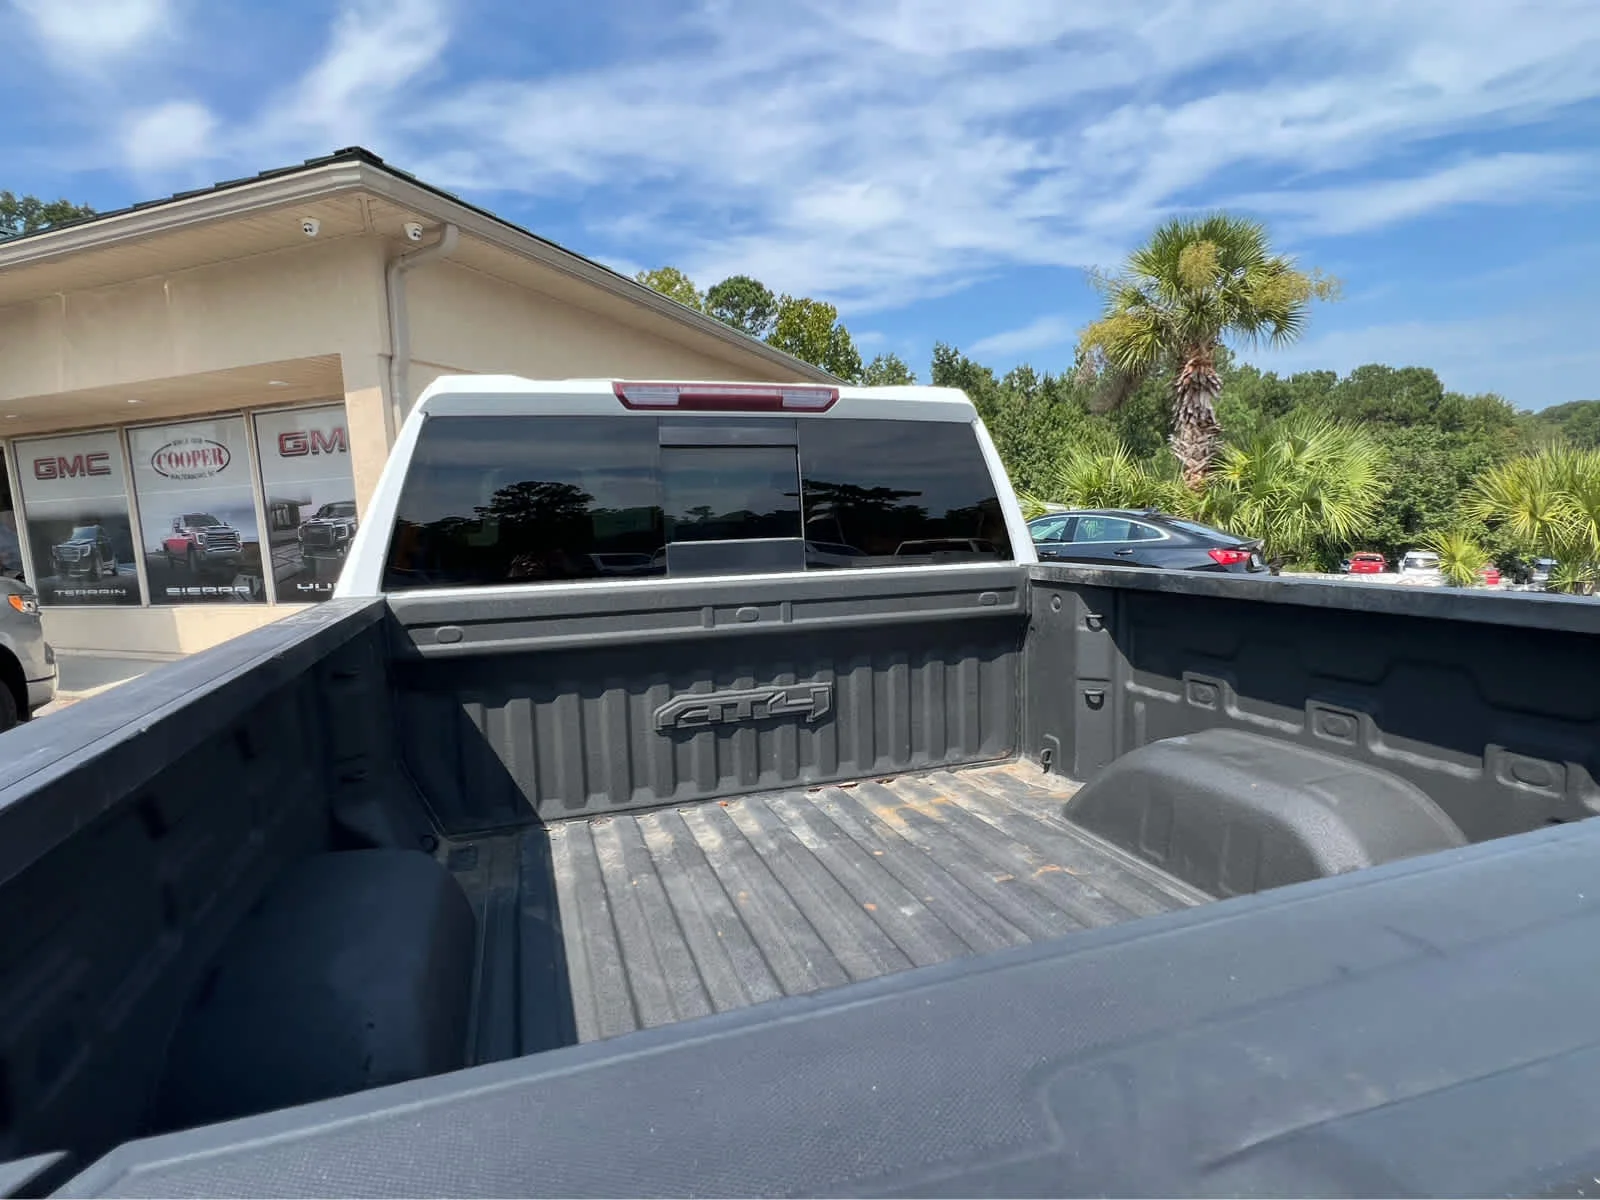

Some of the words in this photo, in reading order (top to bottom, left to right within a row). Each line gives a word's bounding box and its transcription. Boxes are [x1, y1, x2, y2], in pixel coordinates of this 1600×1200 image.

[278, 427, 346, 457] GM
[34, 452, 111, 480] GMC
[156, 447, 224, 472] COOPER
[166, 586, 250, 596] SIERRA
